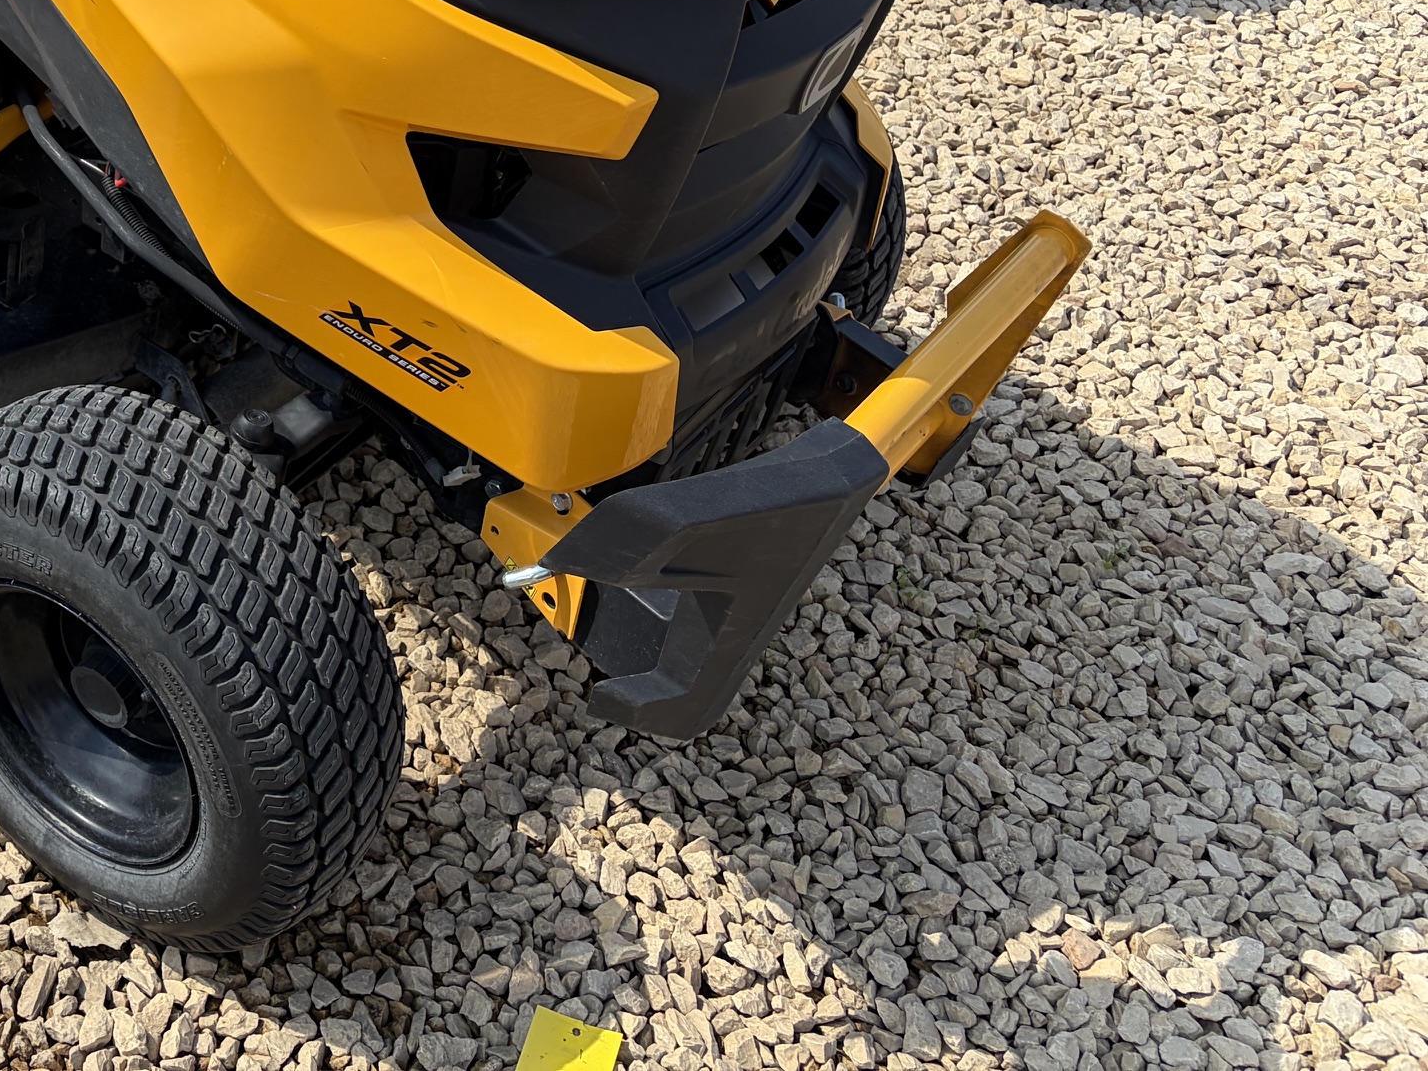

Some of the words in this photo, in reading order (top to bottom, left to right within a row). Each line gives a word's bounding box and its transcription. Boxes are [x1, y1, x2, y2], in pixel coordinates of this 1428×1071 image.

[322, 313, 384, 353] ENDURO
[387, 353, 440, 386] SERIES
[329, 300, 472, 385] XT2
